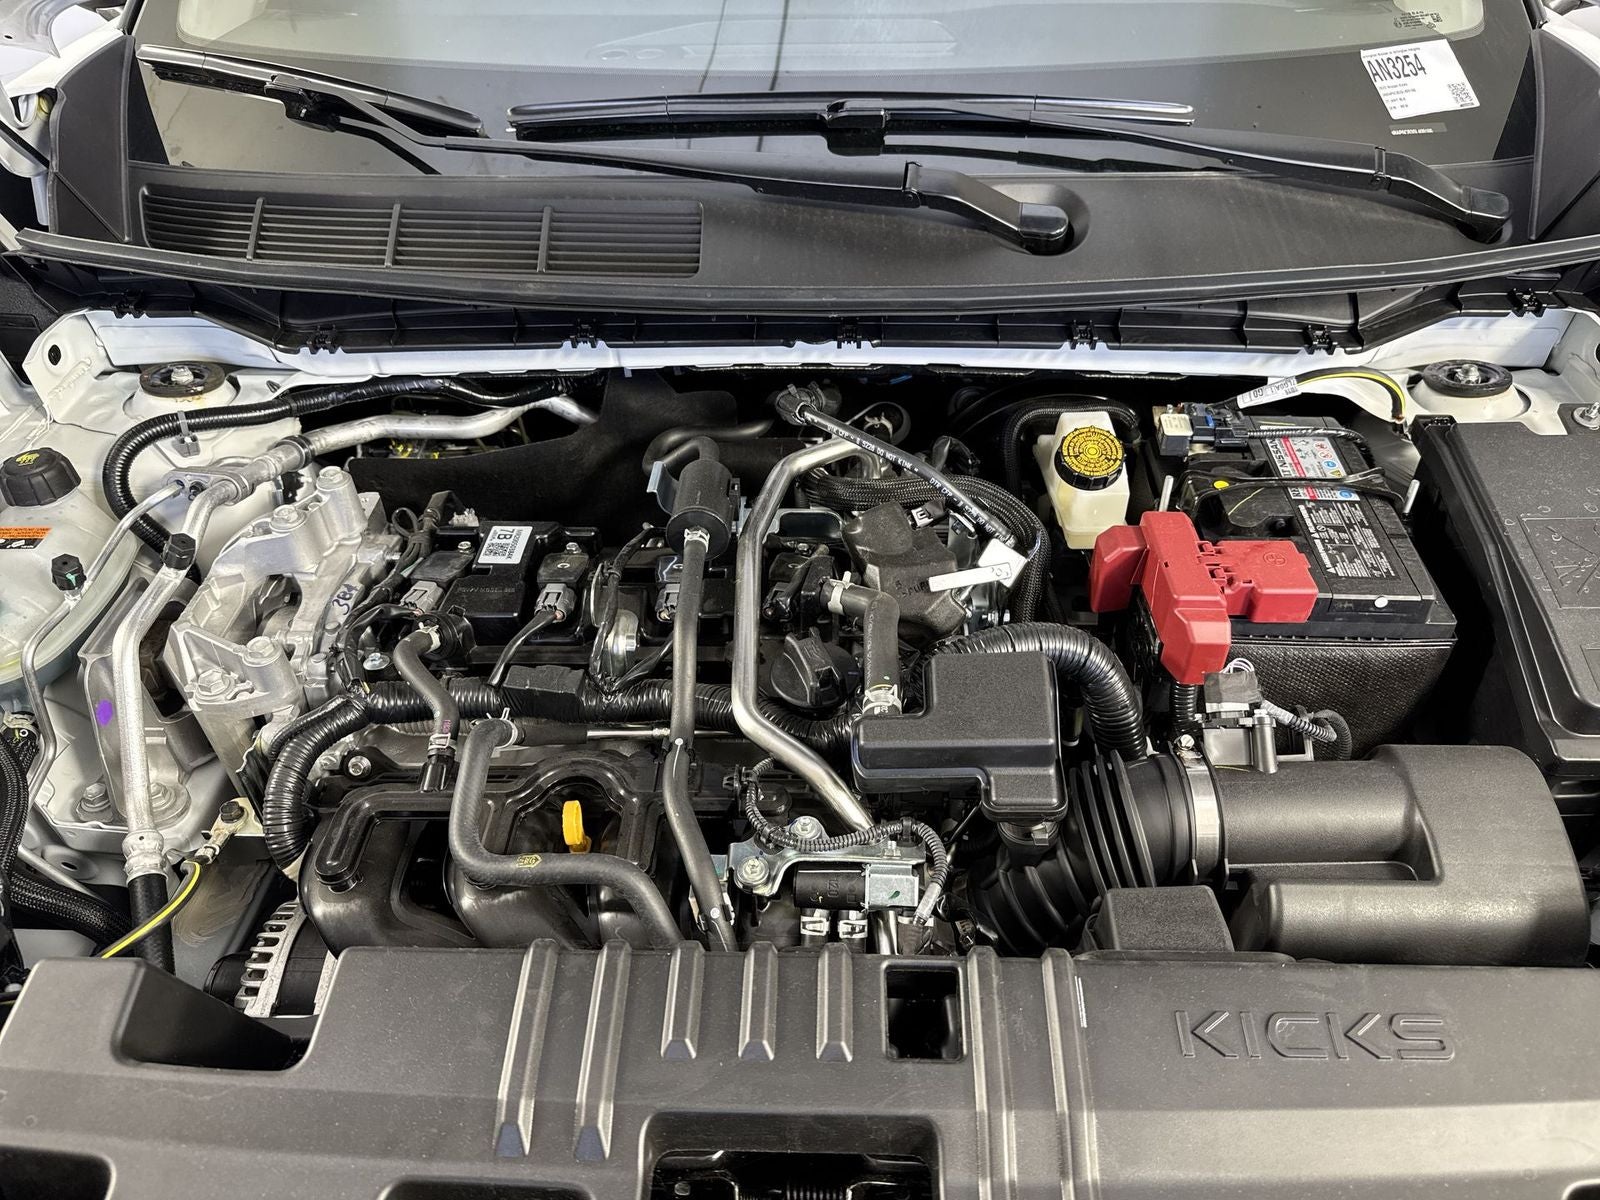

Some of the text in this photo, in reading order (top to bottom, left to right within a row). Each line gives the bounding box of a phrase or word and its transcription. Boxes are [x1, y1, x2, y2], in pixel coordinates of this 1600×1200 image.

[1367, 53, 1427, 82] AN3254
[885, 452, 897, 462] NOT
[897, 458, 913, 469] KINK
[497, 528, 515, 540] 7B
[1174, 1010, 1455, 1062] KICKS
